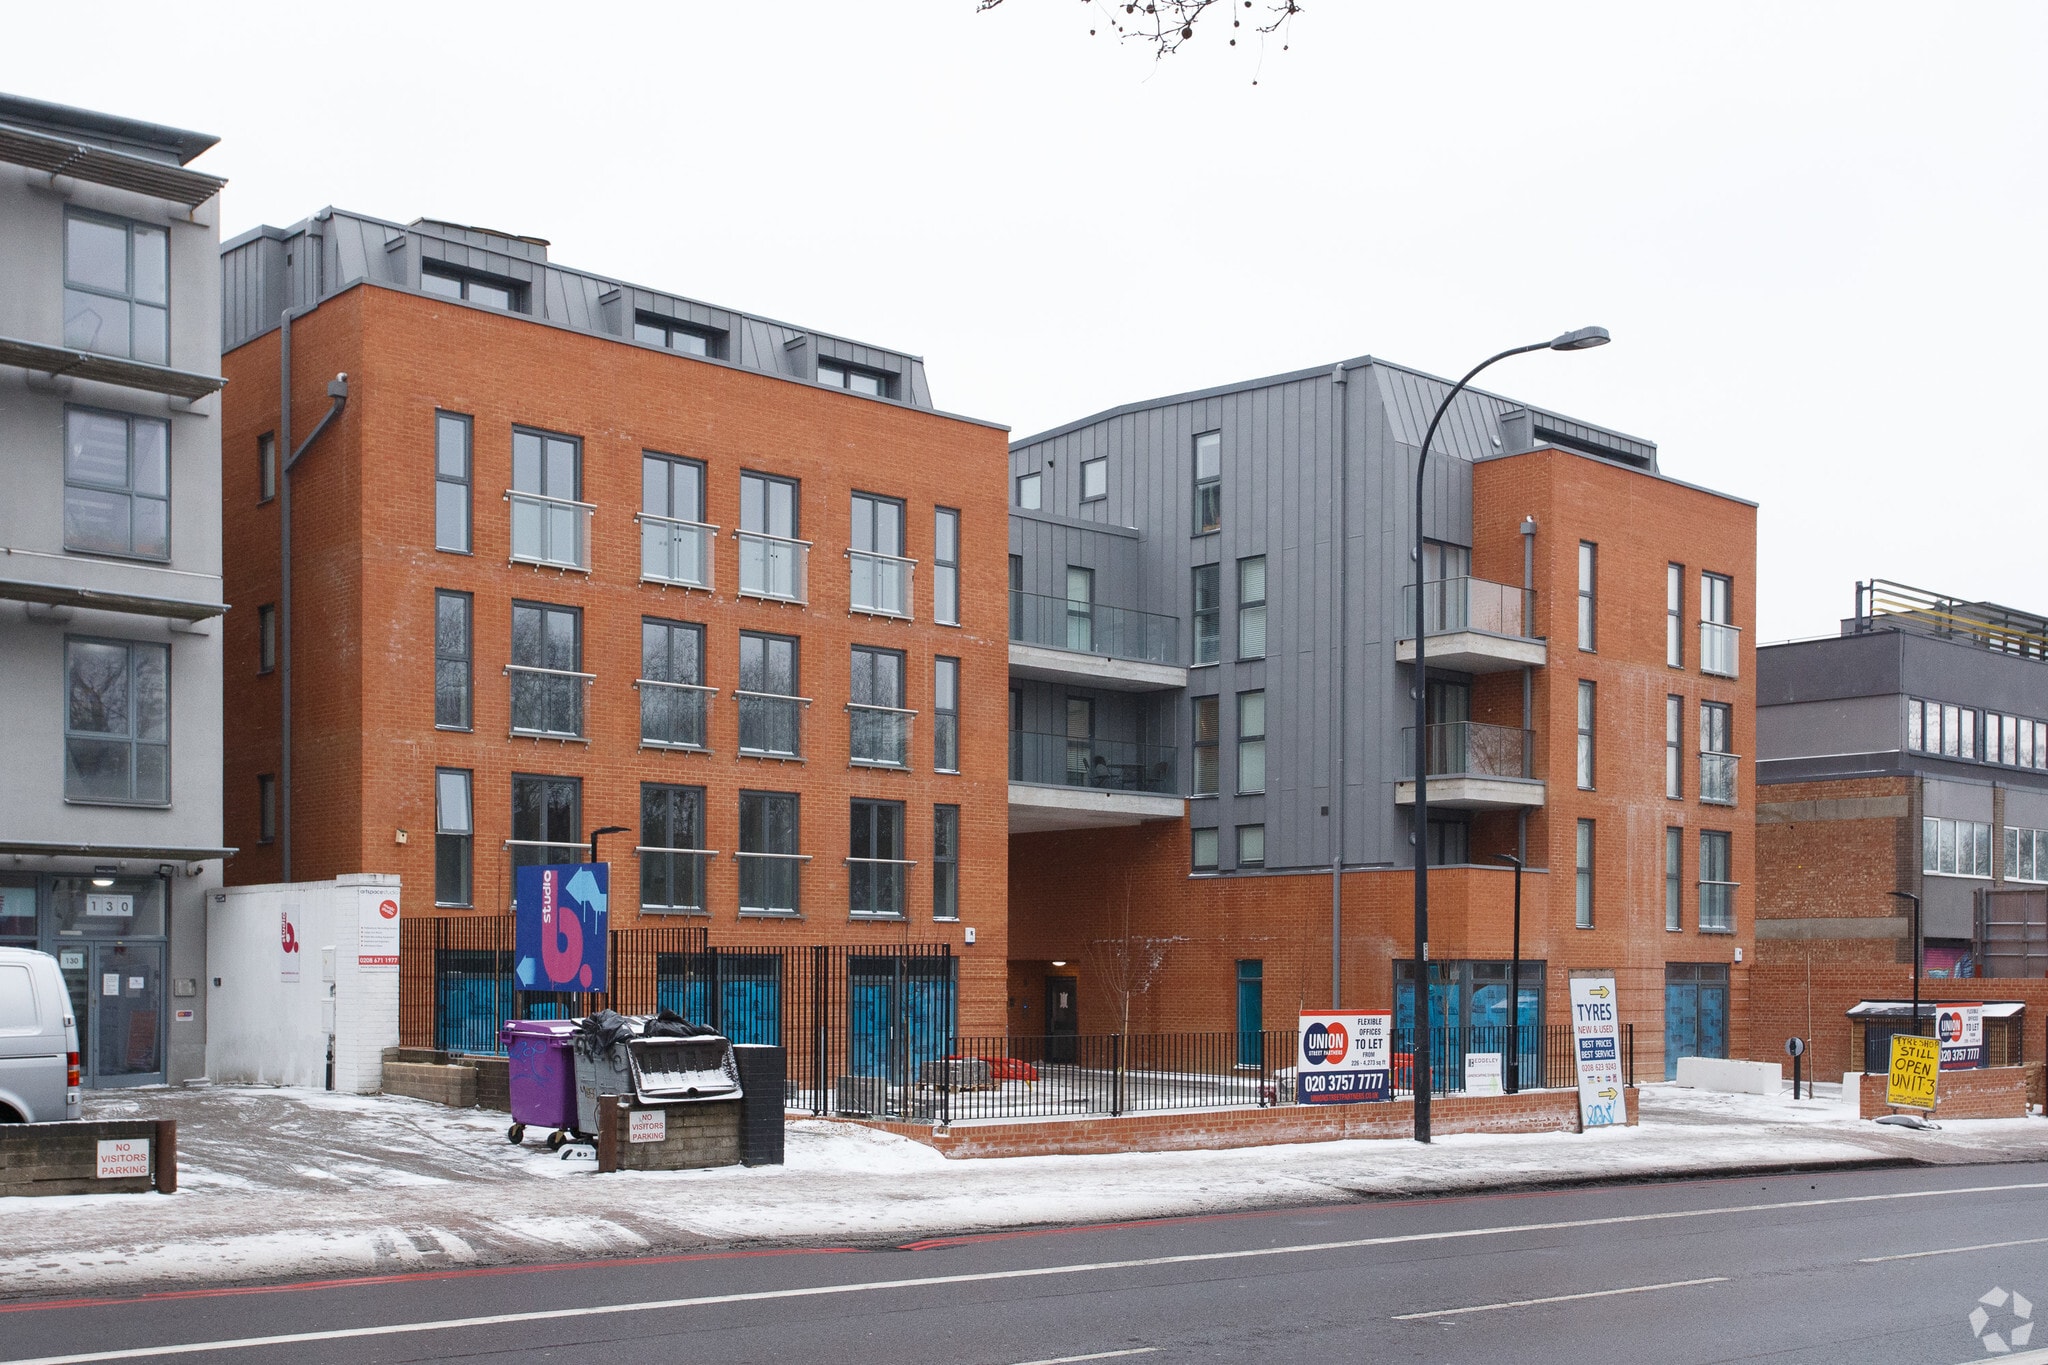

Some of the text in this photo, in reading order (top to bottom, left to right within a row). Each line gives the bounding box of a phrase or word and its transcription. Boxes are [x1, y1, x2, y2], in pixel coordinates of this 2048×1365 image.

[542, 870, 552, 924] studio
[91, 901, 129, 912] 130
[1577, 1003, 1612, 1021] TYRES
[1357, 1018, 1382, 1026] FLEXIBLE
[1941, 1020, 1960, 1032] UNION
[1359, 1028, 1381, 1036] OFFICES
[1578, 1025, 1614, 1034] NEW & USED
[1308, 1033, 1344, 1049] UNION
[1355, 1038, 1383, 1050] TO LET
[1581, 1039, 1613, 1049] BEST PRICES
[1581, 1049, 1615, 1059] BEST SERVICE
[1900, 1046, 1934, 1059] STILL
[1952, 1049, 1966, 1061] 3757
[1967, 1048, 1980, 1060] 7777
[1895, 1058, 1931, 1076] OPEN
[1305, 1073, 1384, 1092] 020 3757 7777
[1892, 1073, 1936, 1095] UNIT 3
[641, 1113, 653, 1121] NO
[632, 1122, 664, 1131] VISITORS
[632, 1132, 664, 1141] PARKING
[115, 1143, 131, 1152] NO
[101, 1153, 147, 1163] VISITORS
[101, 1165, 147, 1175] PARKING
